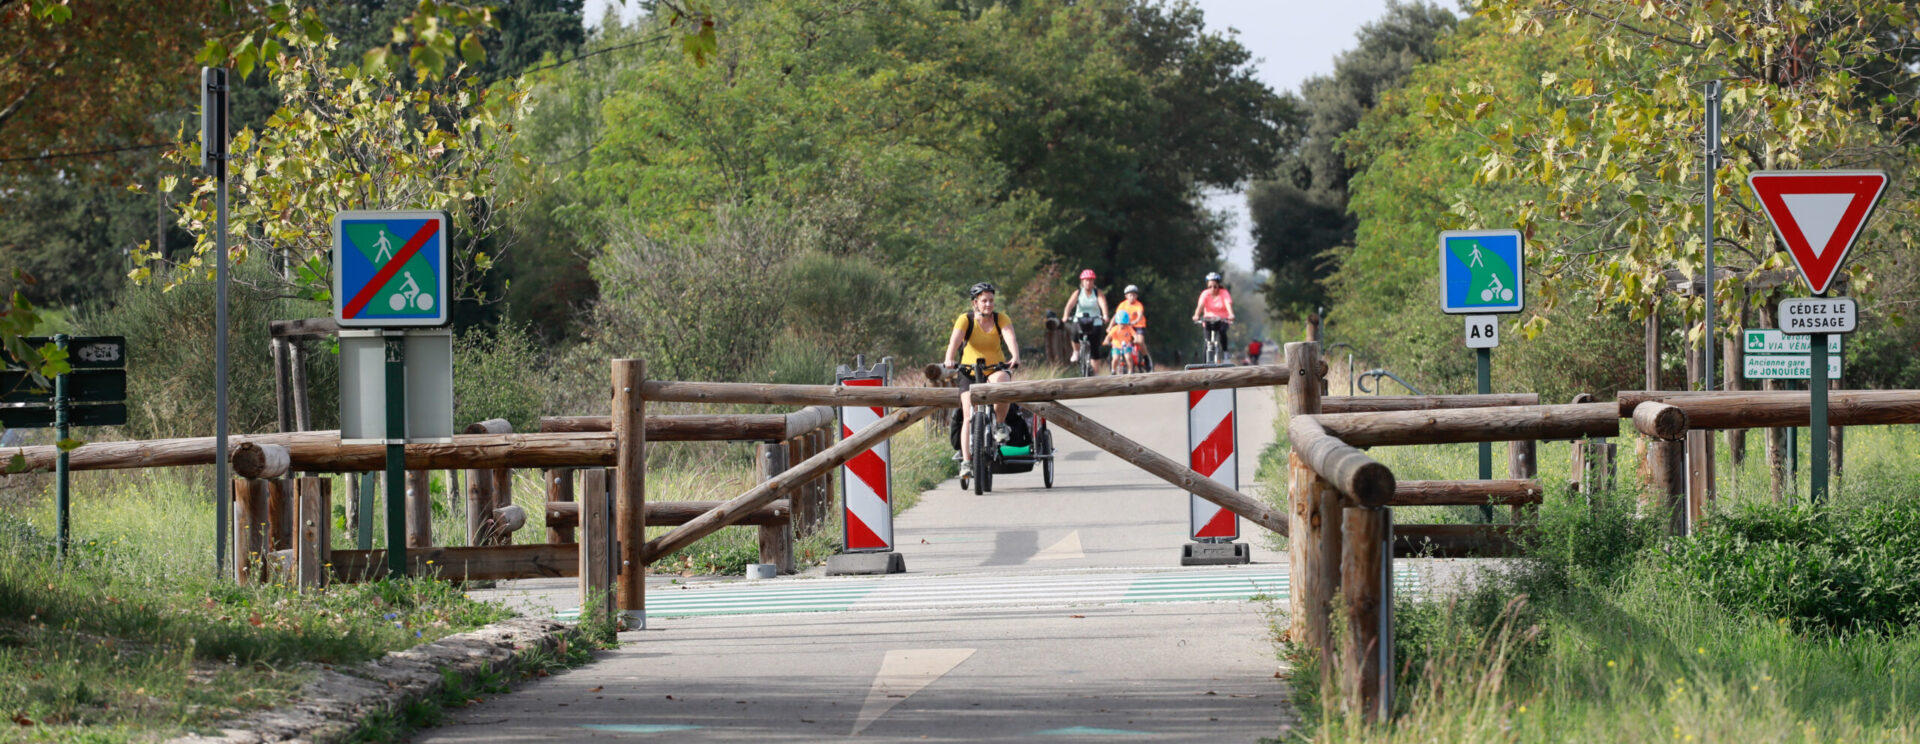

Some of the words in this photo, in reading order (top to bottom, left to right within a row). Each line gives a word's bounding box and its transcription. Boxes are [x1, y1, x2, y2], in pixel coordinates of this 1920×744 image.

[1790, 302, 1827, 315] CÉDEZ
[1833, 304, 1846, 314] LE
[1791, 318, 1845, 328] PASSAGE
[1768, 342, 1783, 350] VIA
[1748, 358, 1785, 367] Ancienne
[1787, 360, 1806, 368] gare
[1748, 368, 1758, 376] de
[1760, 366, 1811, 376] JONQUIÈRE
